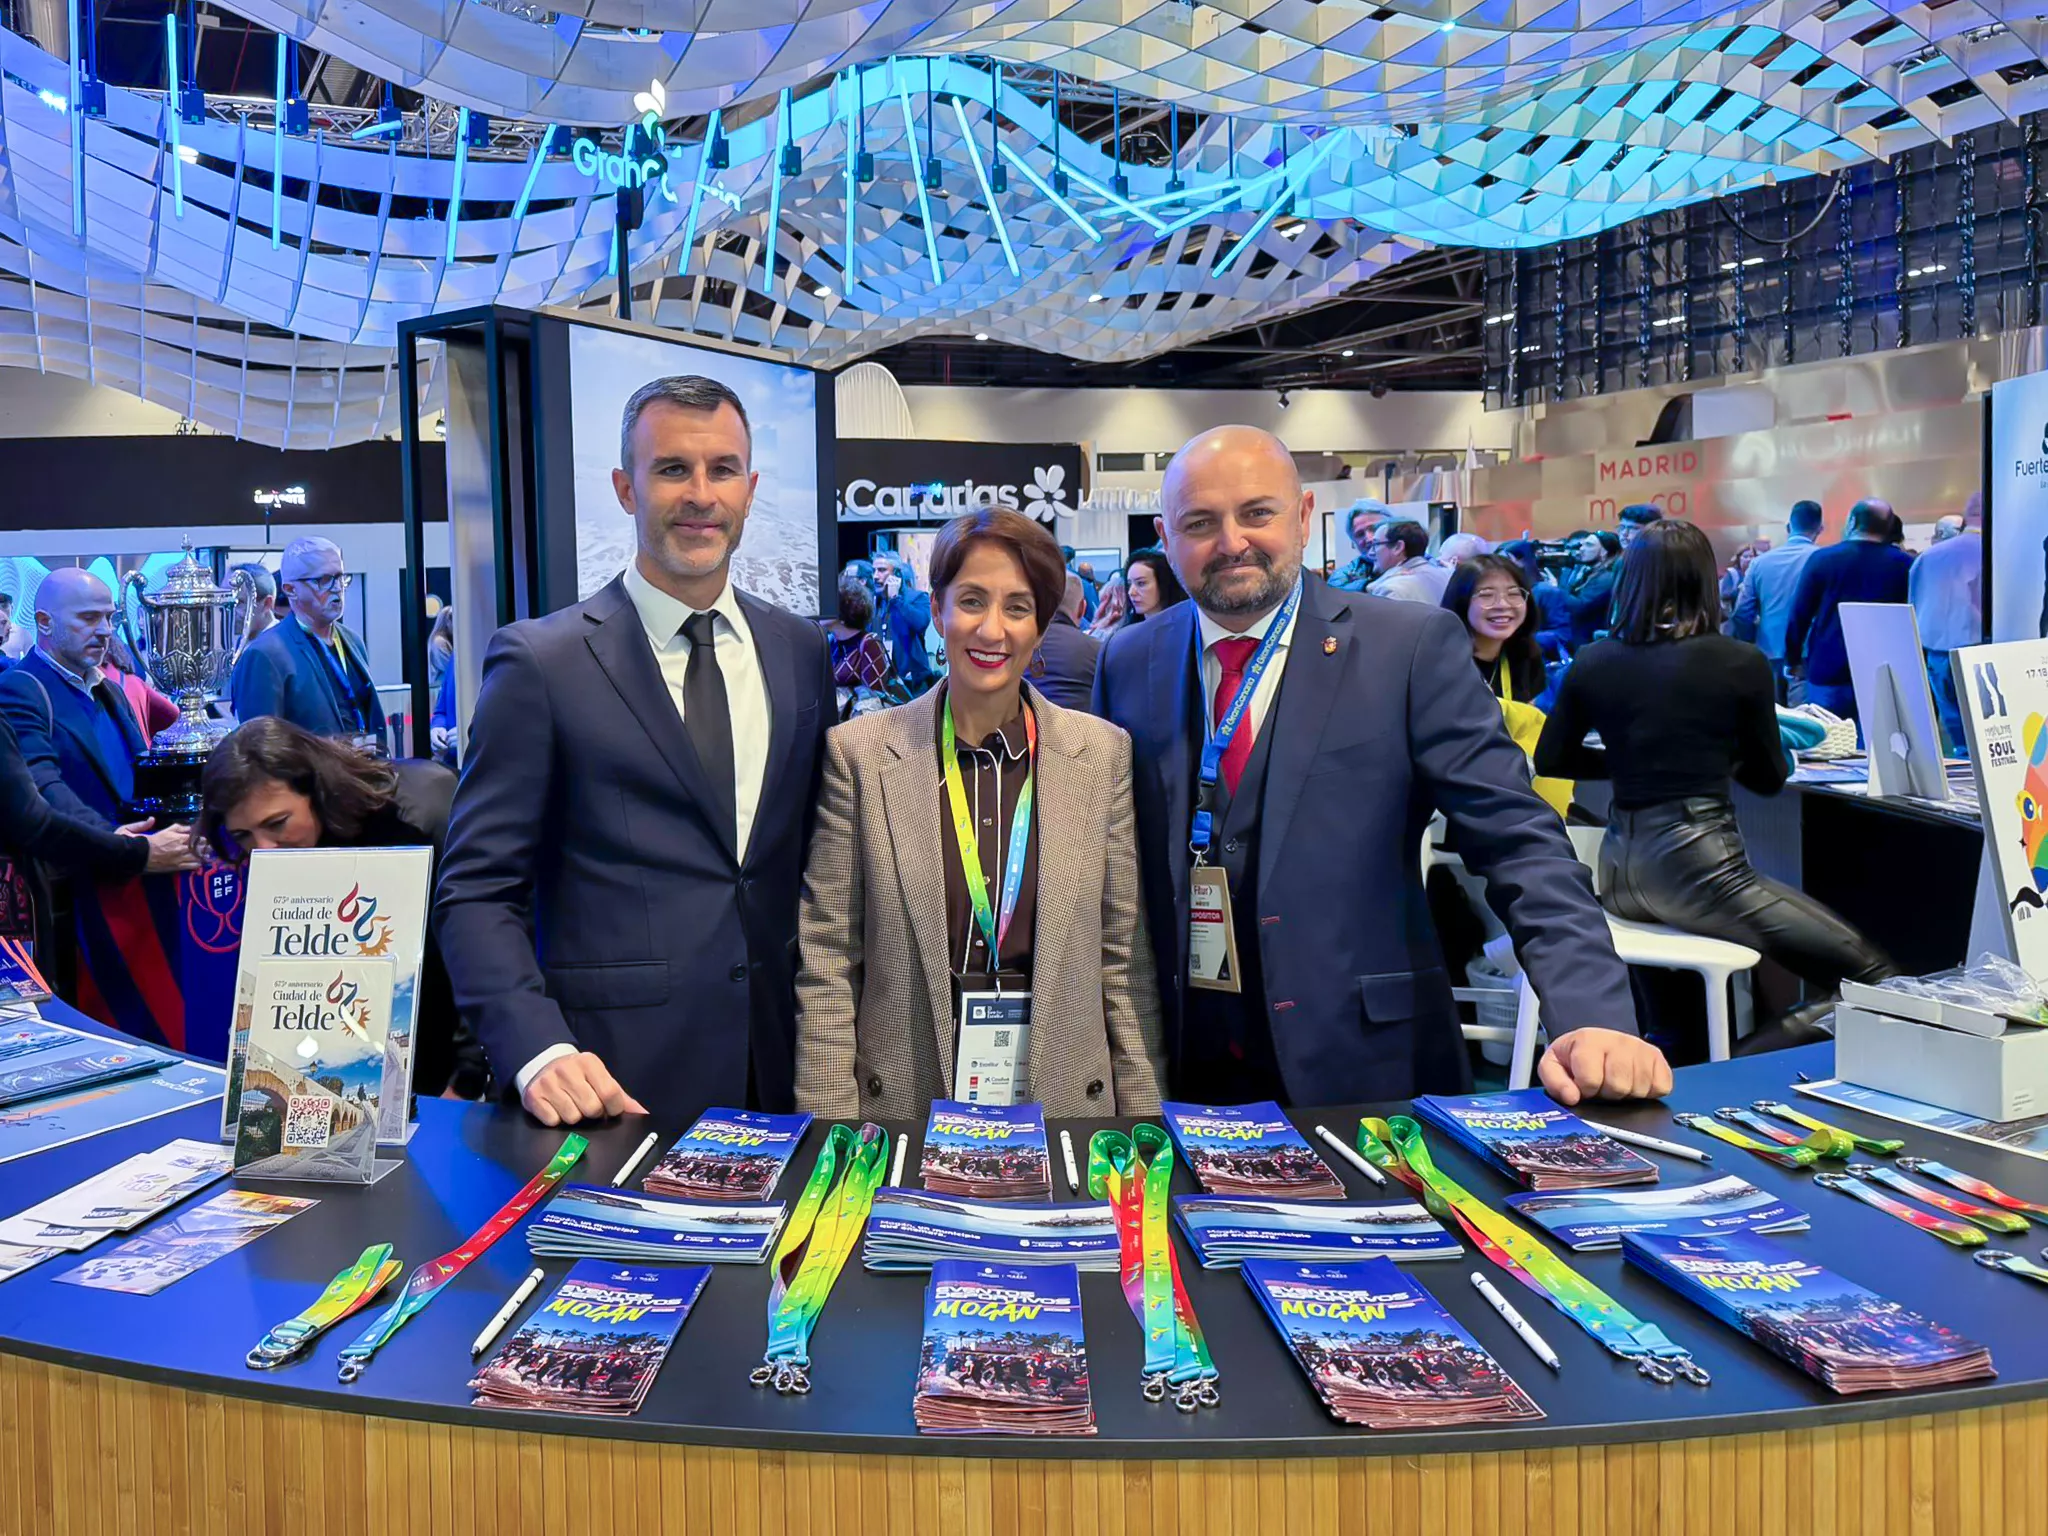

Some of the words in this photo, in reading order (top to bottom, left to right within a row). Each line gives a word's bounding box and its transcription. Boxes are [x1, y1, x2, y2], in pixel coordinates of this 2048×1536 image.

[1600, 451, 1699, 481] MADRID
[1989, 741, 2016, 758] SOUL
[1991, 758, 2018, 768] FESTIVAL
[290, 896, 334, 904] aniversario
[272, 906, 314, 920] Ciudad
[317, 906, 333, 920] de
[269, 923, 349, 955] Telde
[273, 990, 307, 1001] Ciudad
[309, 990, 322, 1001] de
[270, 1003, 335, 1031] Telde
